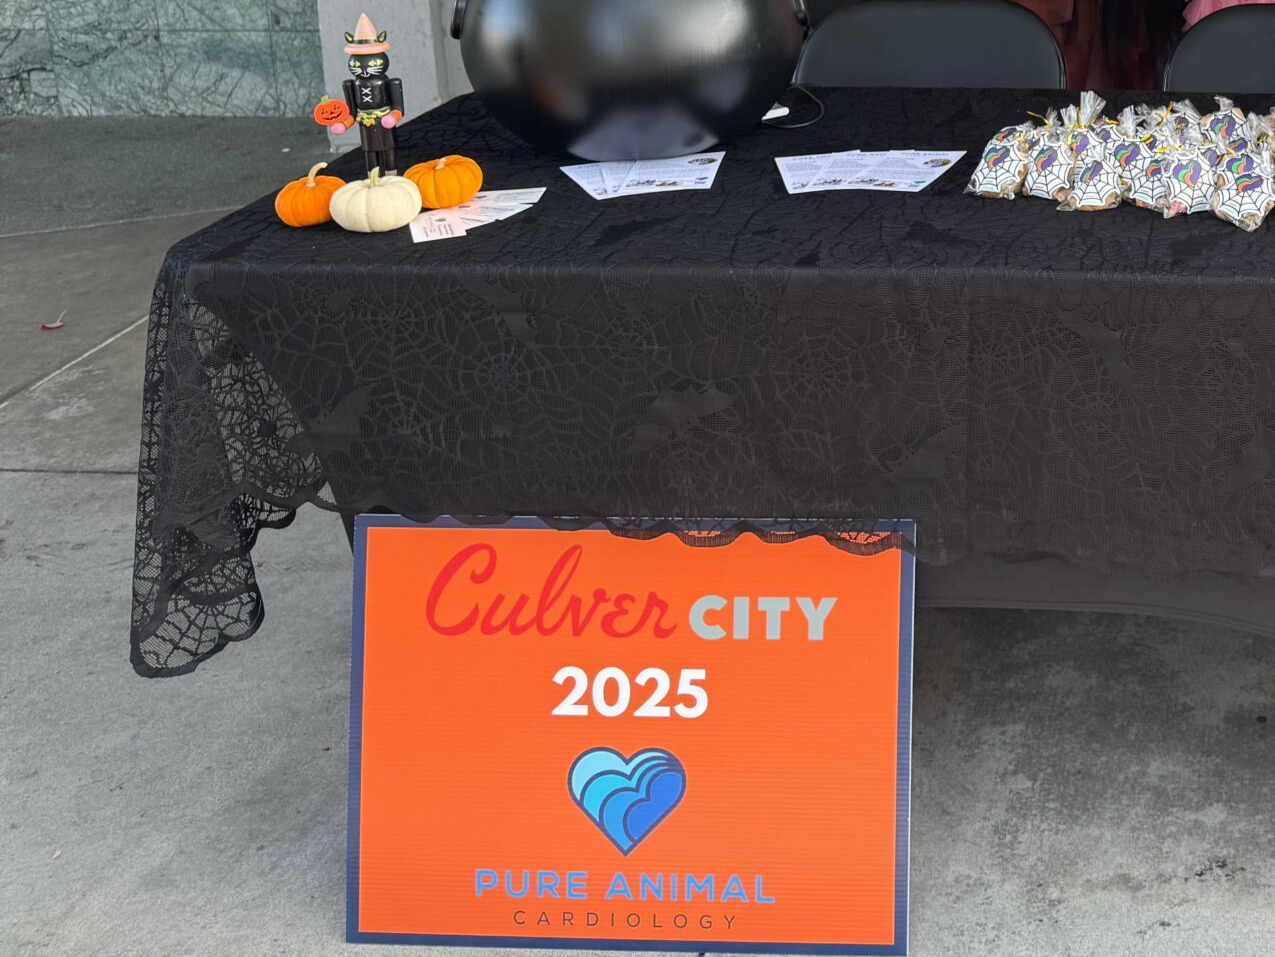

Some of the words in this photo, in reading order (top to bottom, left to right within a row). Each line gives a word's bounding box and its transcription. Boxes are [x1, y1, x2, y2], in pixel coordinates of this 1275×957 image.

[426, 543, 678, 638] Culver
[689, 595, 838, 641] CITY
[551, 666, 709, 718] 2025
[475, 869, 588, 899] PURE
[605, 872, 776, 904] ANIMAL
[513, 910, 736, 930] CARDIOLOGY
